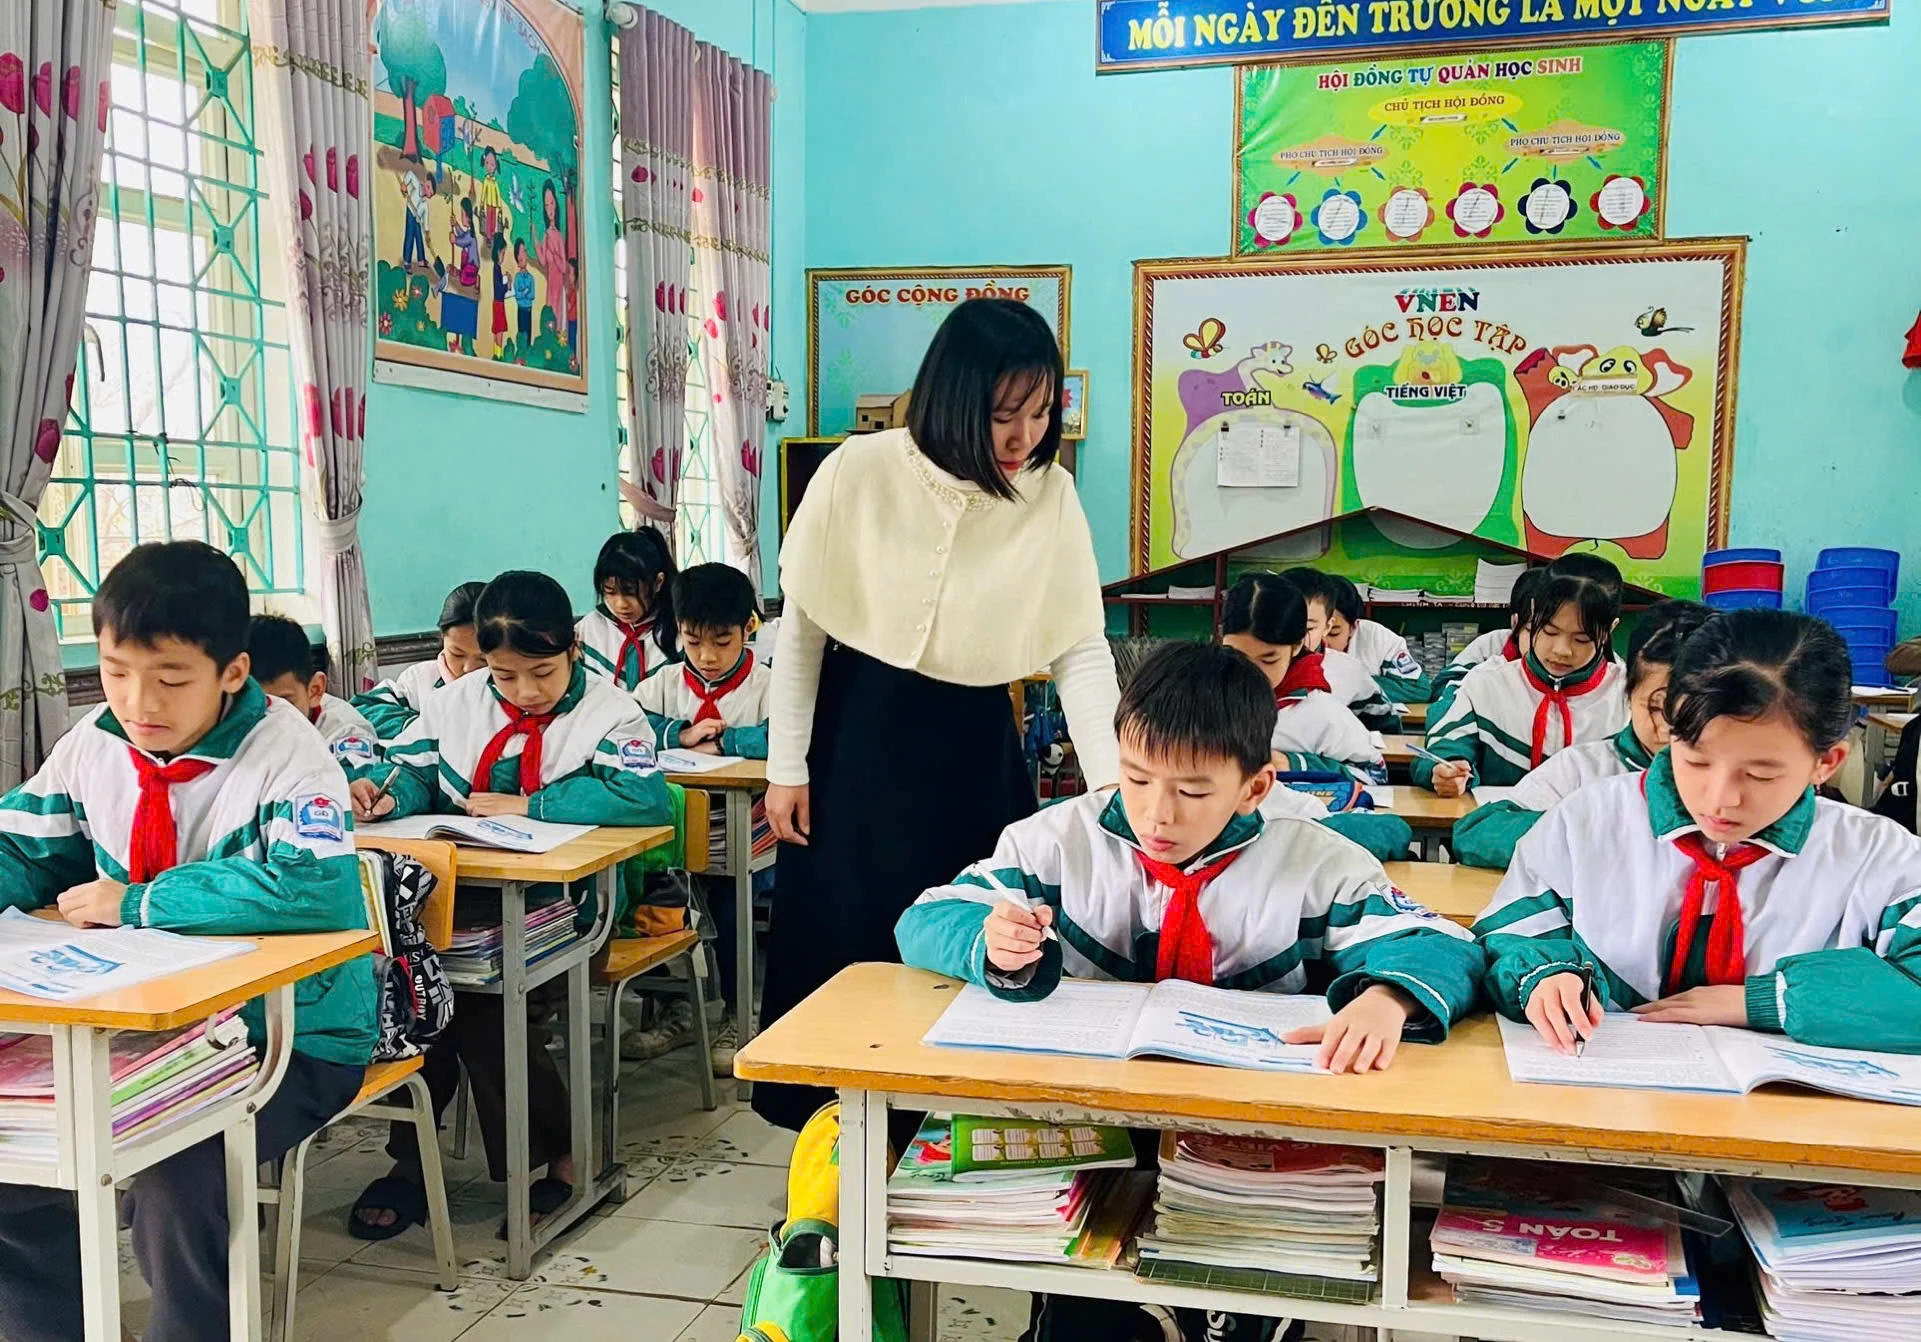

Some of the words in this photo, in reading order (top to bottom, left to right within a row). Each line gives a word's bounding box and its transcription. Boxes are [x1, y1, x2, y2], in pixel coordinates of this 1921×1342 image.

[1128, 2, 1186, 50] MỖI
[1194, 0, 1285, 46] NGÀY
[1318, 69, 1348, 92] HỘI
[1353, 64, 1403, 87] ĐỒNG
[1407, 65, 1433, 86] TỰ
[1438, 59, 1490, 84] QUẢN
[1495, 61, 1532, 80] HỌC
[1537, 57, 1582, 75] SINH
[1444, 96, 1466, 109] HỘI
[845, 284, 891, 303] GÓC
[896, 284, 959, 306] CỘNG
[1394, 290, 1480, 313] VNEN
[1345, 322, 1399, 358] GÓC
[1406, 316, 1462, 341] HỌC
[1474, 320, 1527, 355] TẬP
[1220, 388, 1271, 407] TOÁN
[1386, 382, 1429, 399] TIẾNG
[1434, 383, 1466, 400] VIỆT
[1481, 1219, 1505, 1233] 5
[1519, 1221, 1624, 1243] TOÁN
